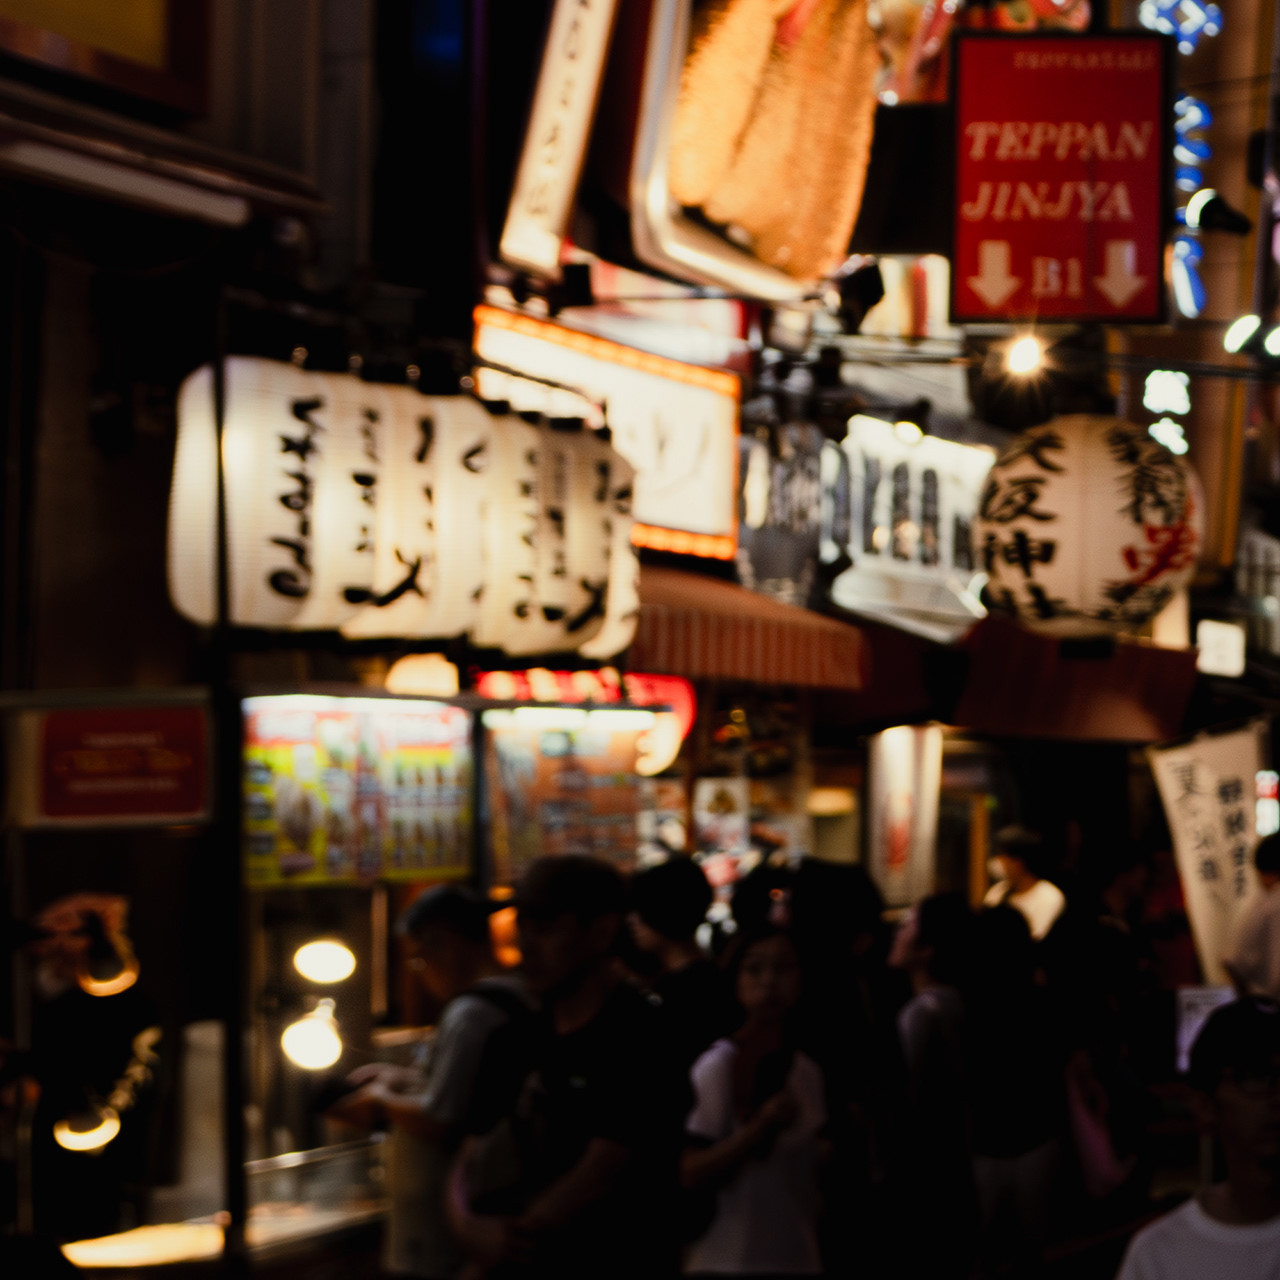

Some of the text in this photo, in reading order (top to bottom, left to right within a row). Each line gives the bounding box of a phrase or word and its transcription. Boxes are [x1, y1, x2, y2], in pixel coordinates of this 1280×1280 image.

[962, 120, 1155, 162] TEPPAN
[960, 180, 1135, 222] JINJYA
[1030, 255, 1083, 300] B1
